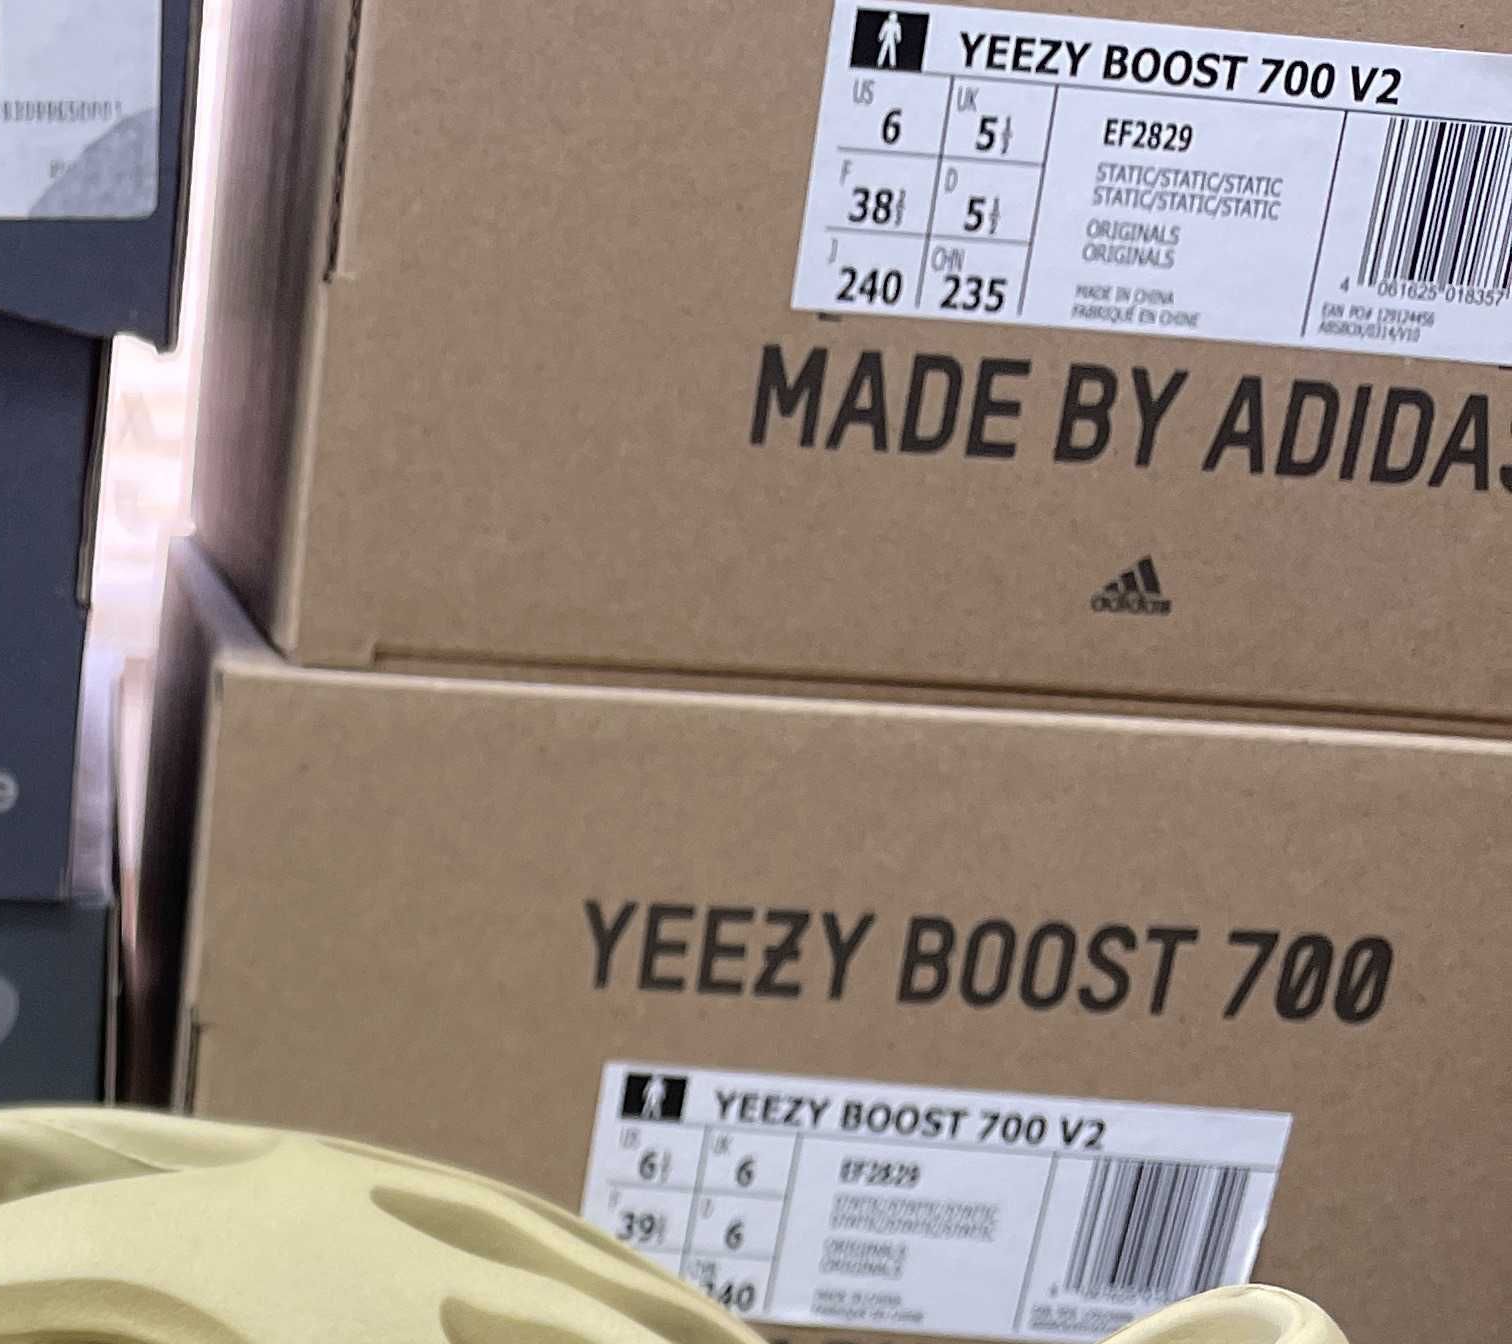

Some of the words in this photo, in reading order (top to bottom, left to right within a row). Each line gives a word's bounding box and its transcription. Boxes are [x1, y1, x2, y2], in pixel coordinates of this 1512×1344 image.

[960, 32, 1091, 77] YEEZY
[1103, 46, 1247, 91] BOOST
[1259, 57, 1337, 101] 700
[1350, 64, 1402, 105] V2
[853, 79, 875, 104] US
[957, 87, 978, 112] UK
[882, 109, 901, 144] 6
[1103, 118, 1193, 152] EF2829
[1096, 162, 1284, 197] STATIC/STATIC/STATIC
[1092, 186, 1281, 220] STATIC/STATIC/STATIC
[1086, 218, 1181, 245] ORIGINALS
[1082, 243, 1175, 269] ORIGINALS
[836, 267, 902, 306] 240
[941, 275, 1007, 312] 235
[1340, 276, 1350, 292] 4
[749, 344, 1031, 458] MADE
[1054, 363, 1188, 467] BY
[1202, 375, 1512, 493] ADIDA
[585, 899, 875, 1001] YEEZY
[897, 915, 1199, 1016] BOOST
[1223, 928, 1394, 1024] 700
[715, 1090, 831, 1128] YEEZY
[840, 1100, 968, 1138] BOOST
[977, 1109, 1047, 1145] 700
[1061, 1115, 1106, 1149] V2
[737, 1155, 754, 1188] 6
[725, 1218, 744, 1250] 6
